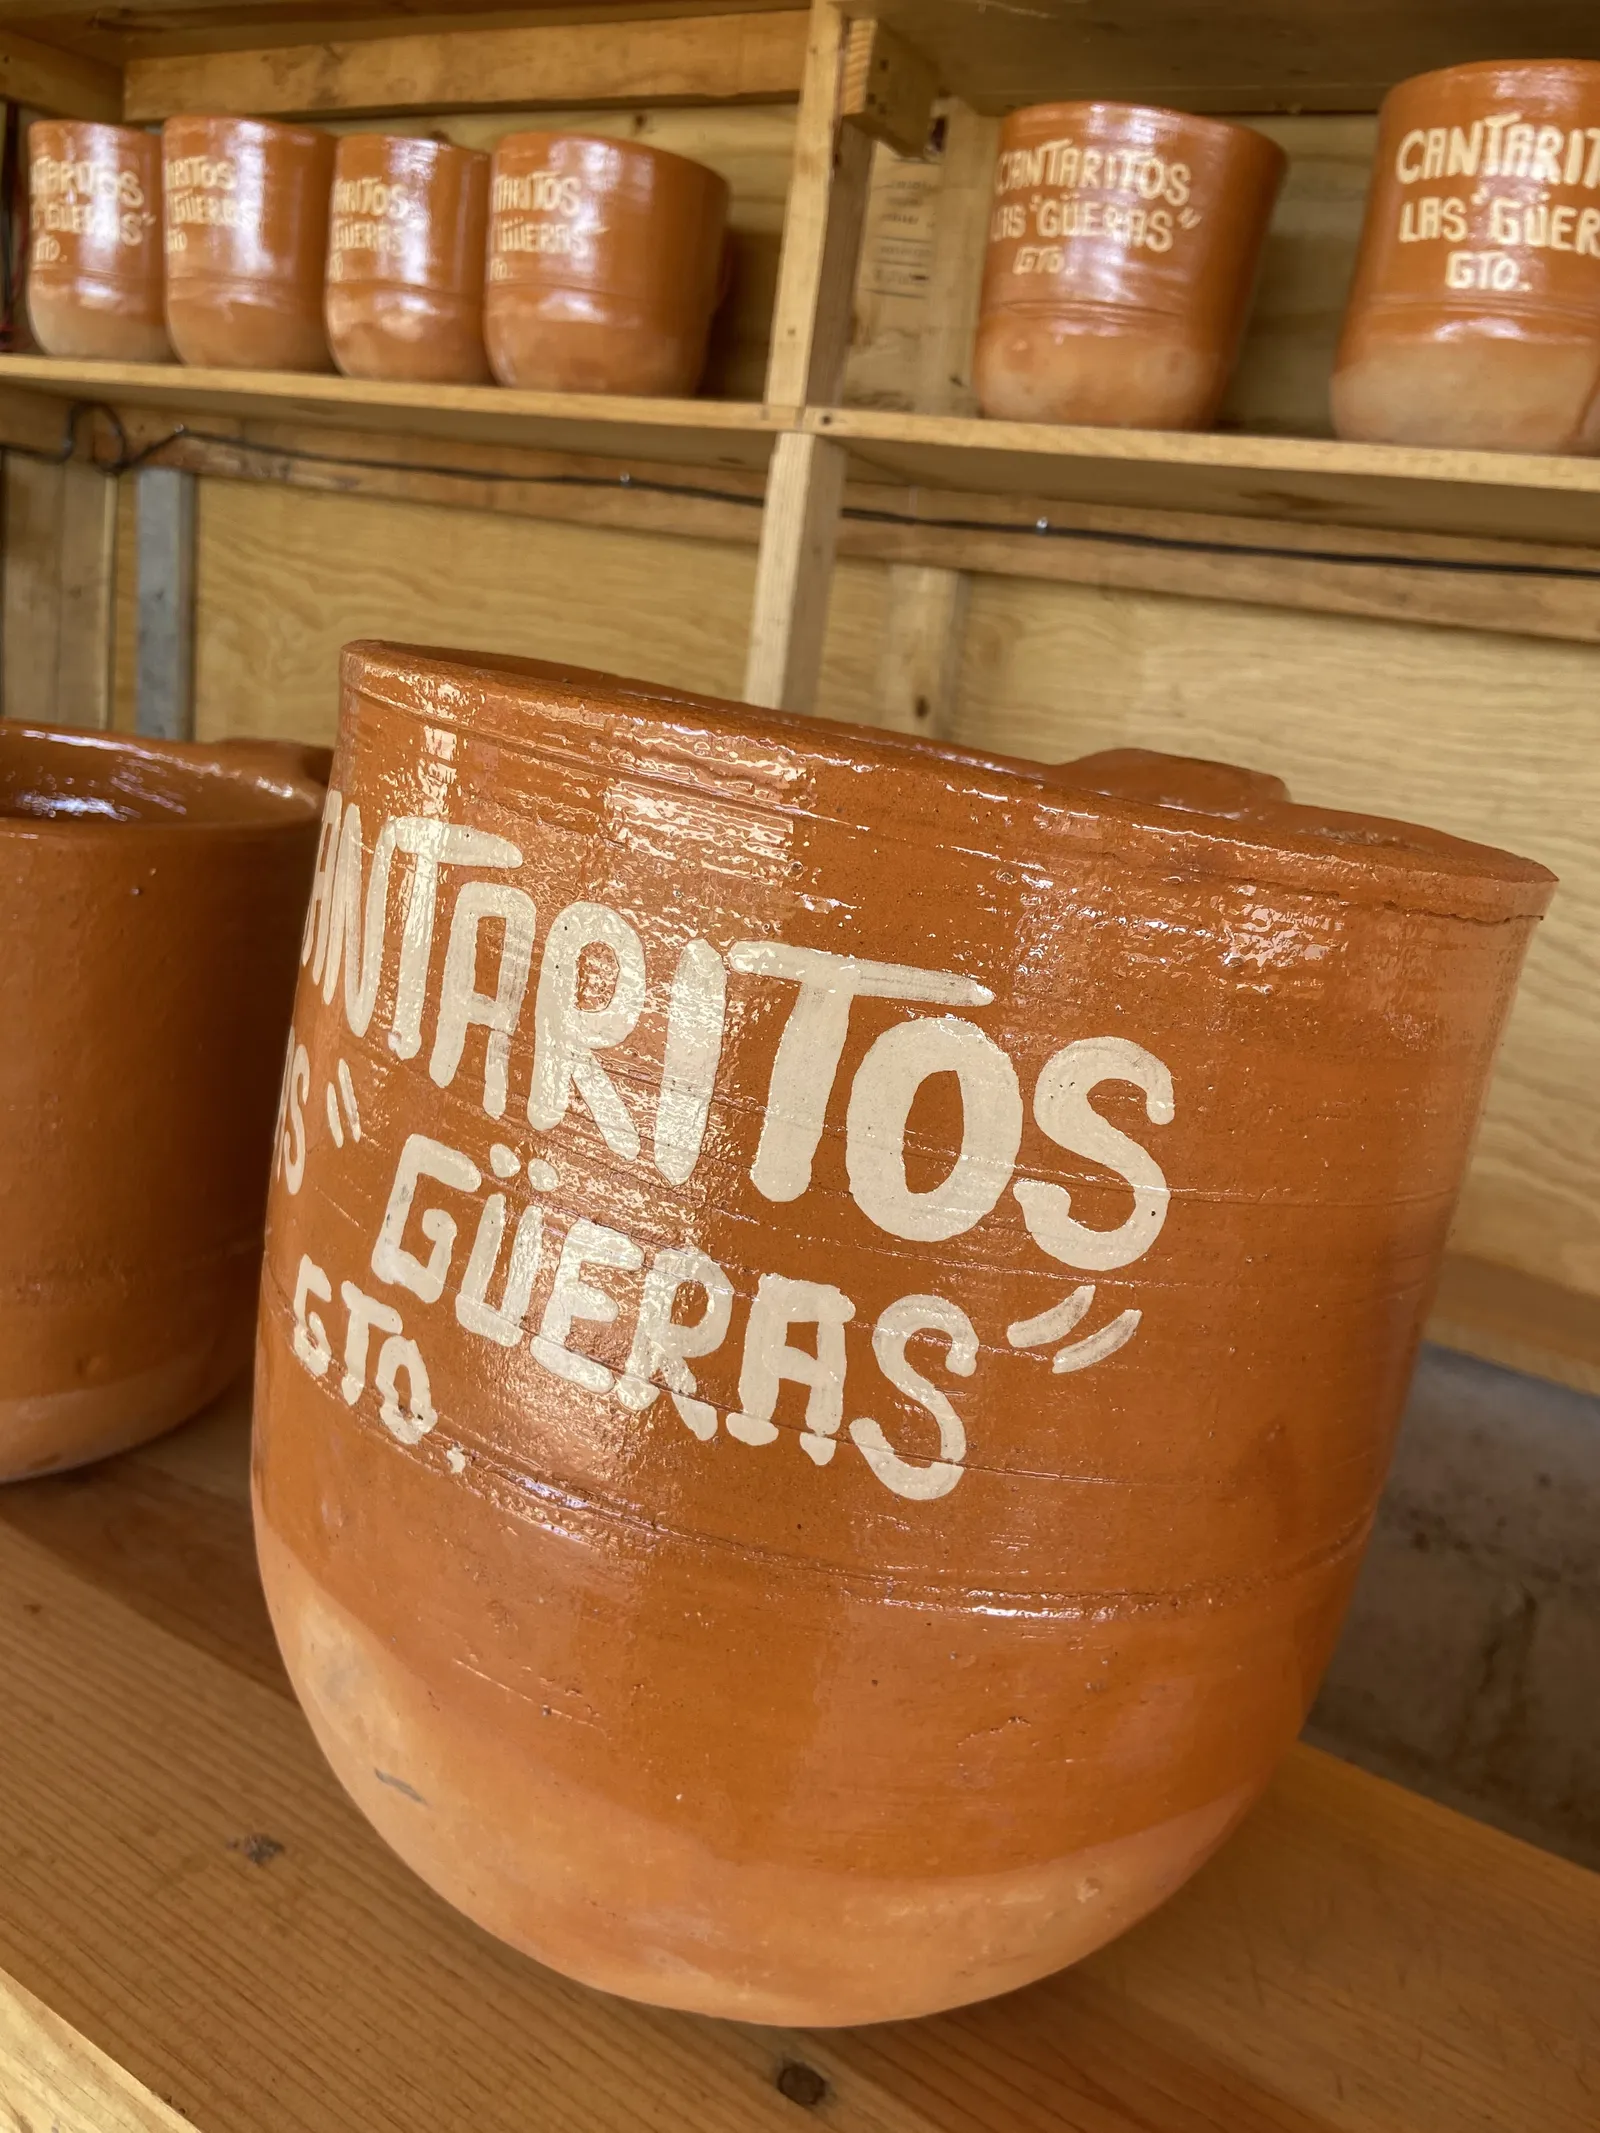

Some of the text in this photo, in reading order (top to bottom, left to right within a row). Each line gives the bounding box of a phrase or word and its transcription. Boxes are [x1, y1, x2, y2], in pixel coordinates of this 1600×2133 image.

[995, 138, 1191, 206] CANTARITOS
[1396, 112, 1600, 189] CANTARIT
[1399, 196, 1468, 243] LAS
[301, 788, 1175, 1271] ANTARITOS
